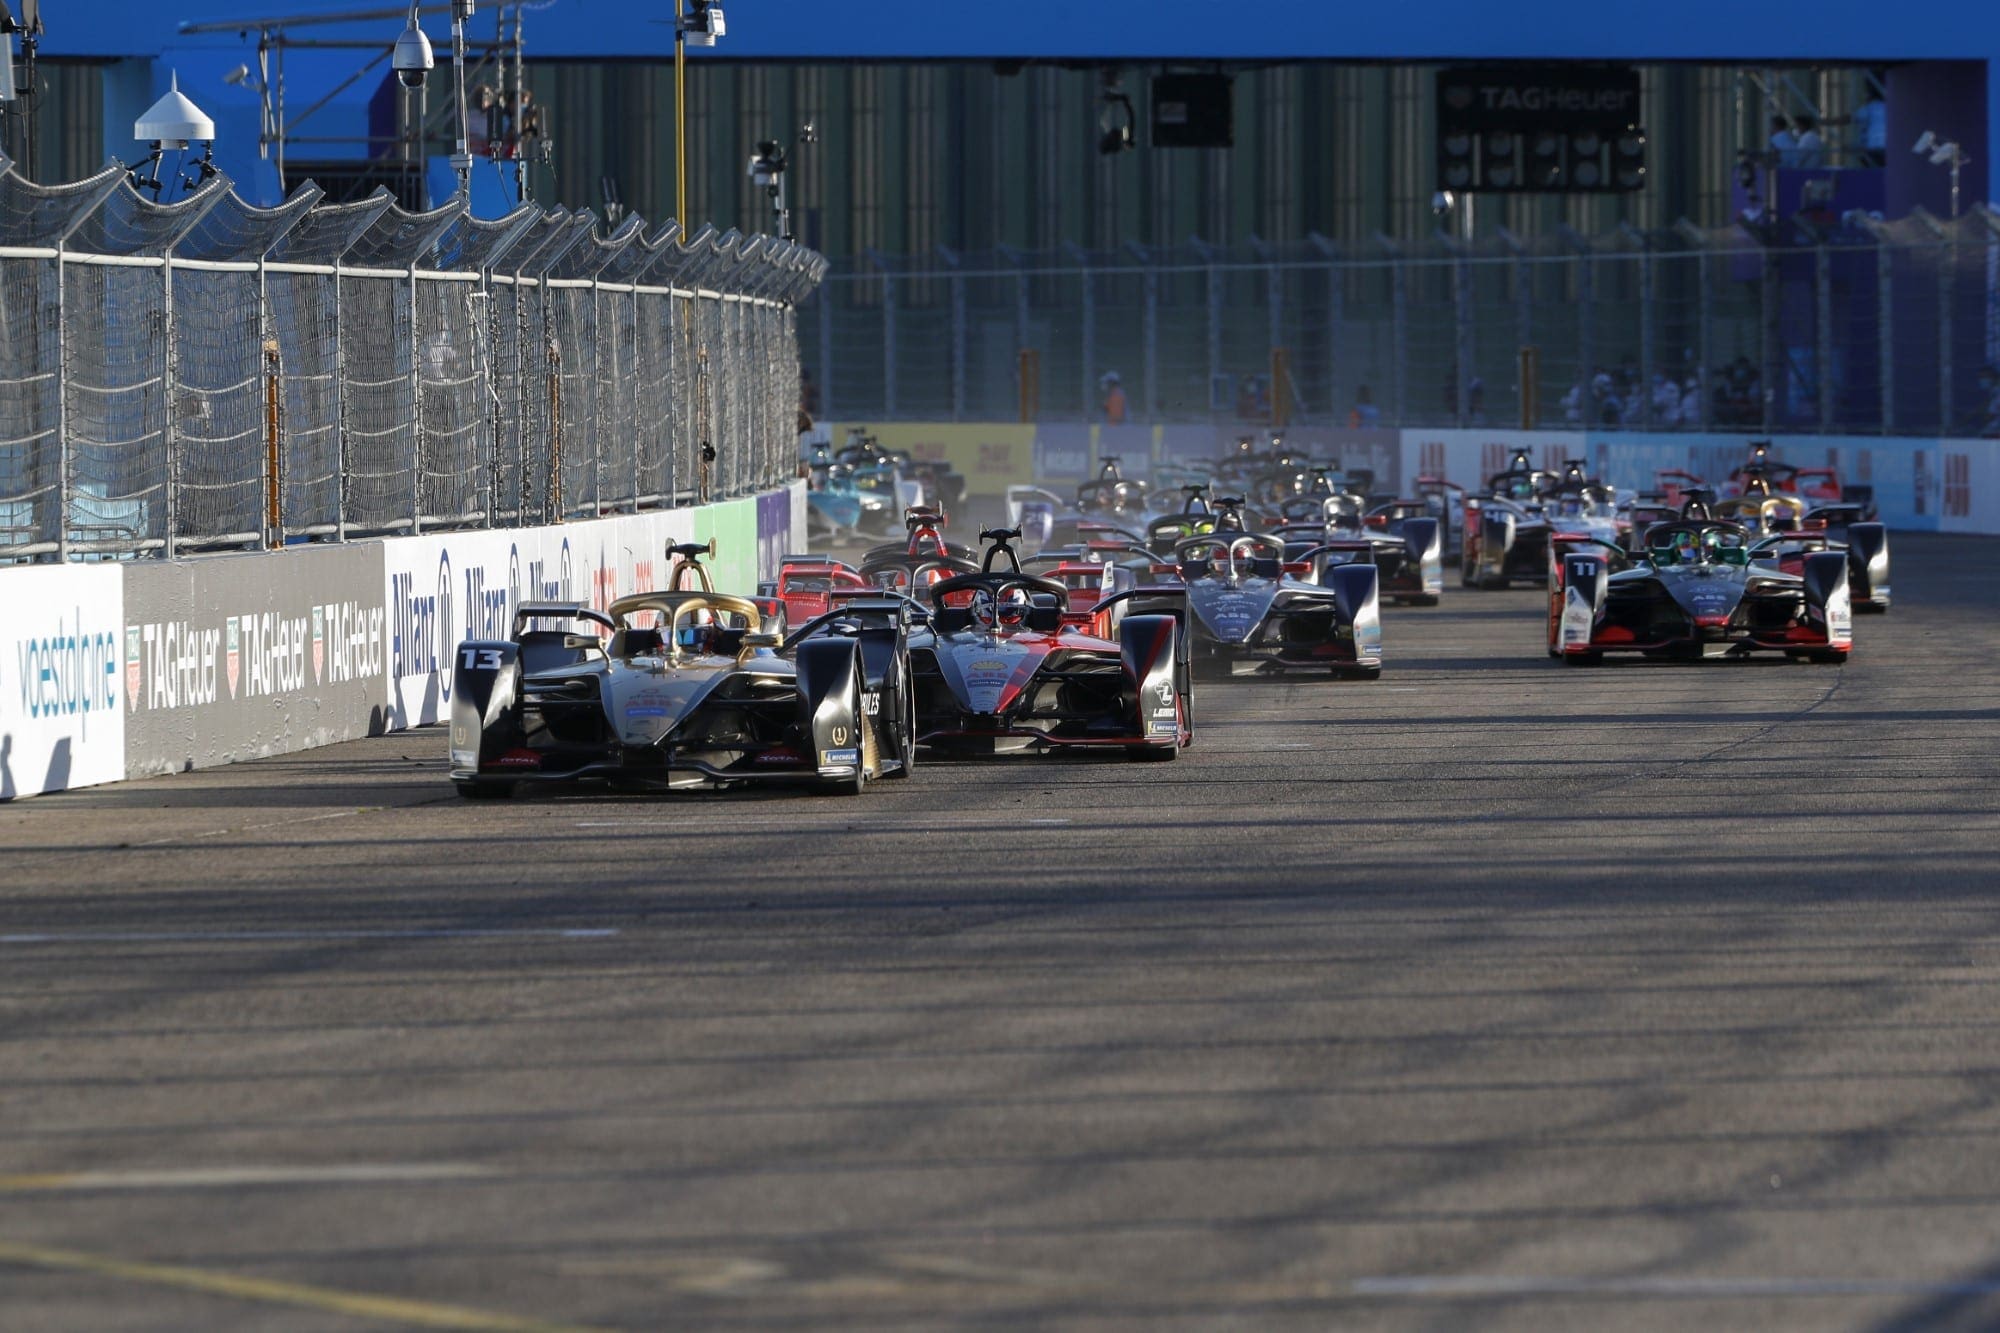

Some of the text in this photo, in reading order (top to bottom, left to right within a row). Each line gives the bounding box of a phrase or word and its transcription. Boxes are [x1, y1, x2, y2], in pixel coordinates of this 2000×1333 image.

[1480, 86, 1632, 110] TAGHeuer
[1573, 562, 1595, 576] 11
[144, 621, 219, 710] TAGHeuer
[242, 611, 307, 697] TAGHeuer
[325, 601, 383, 683] TAGHeuer
[393, 571, 436, 678] Allianz
[461, 649, 503, 670] 13
[17, 605, 115, 743] voestalpine
